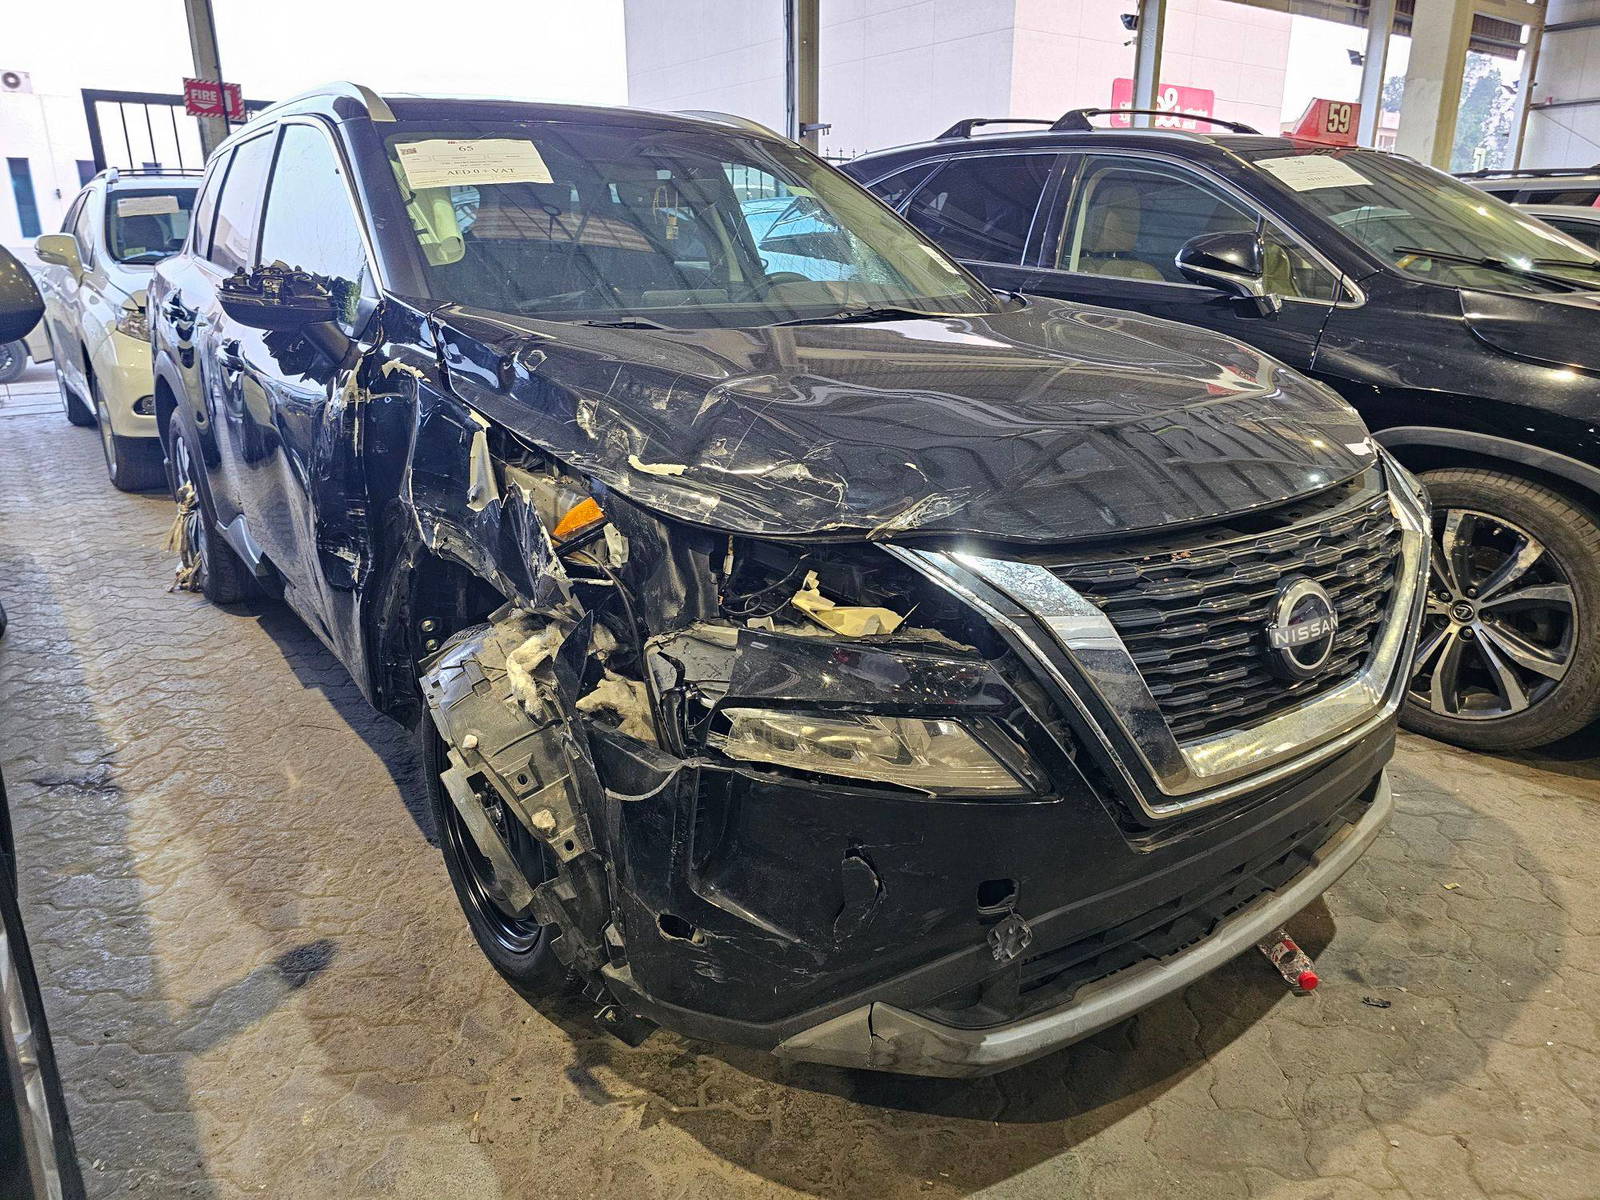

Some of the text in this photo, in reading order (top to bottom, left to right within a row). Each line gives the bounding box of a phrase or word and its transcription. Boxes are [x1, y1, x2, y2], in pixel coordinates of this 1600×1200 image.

[190, 89, 217, 102] FIRE
[1327, 103, 1351, 133] 59
[1274, 614, 1339, 646] NISSAN
